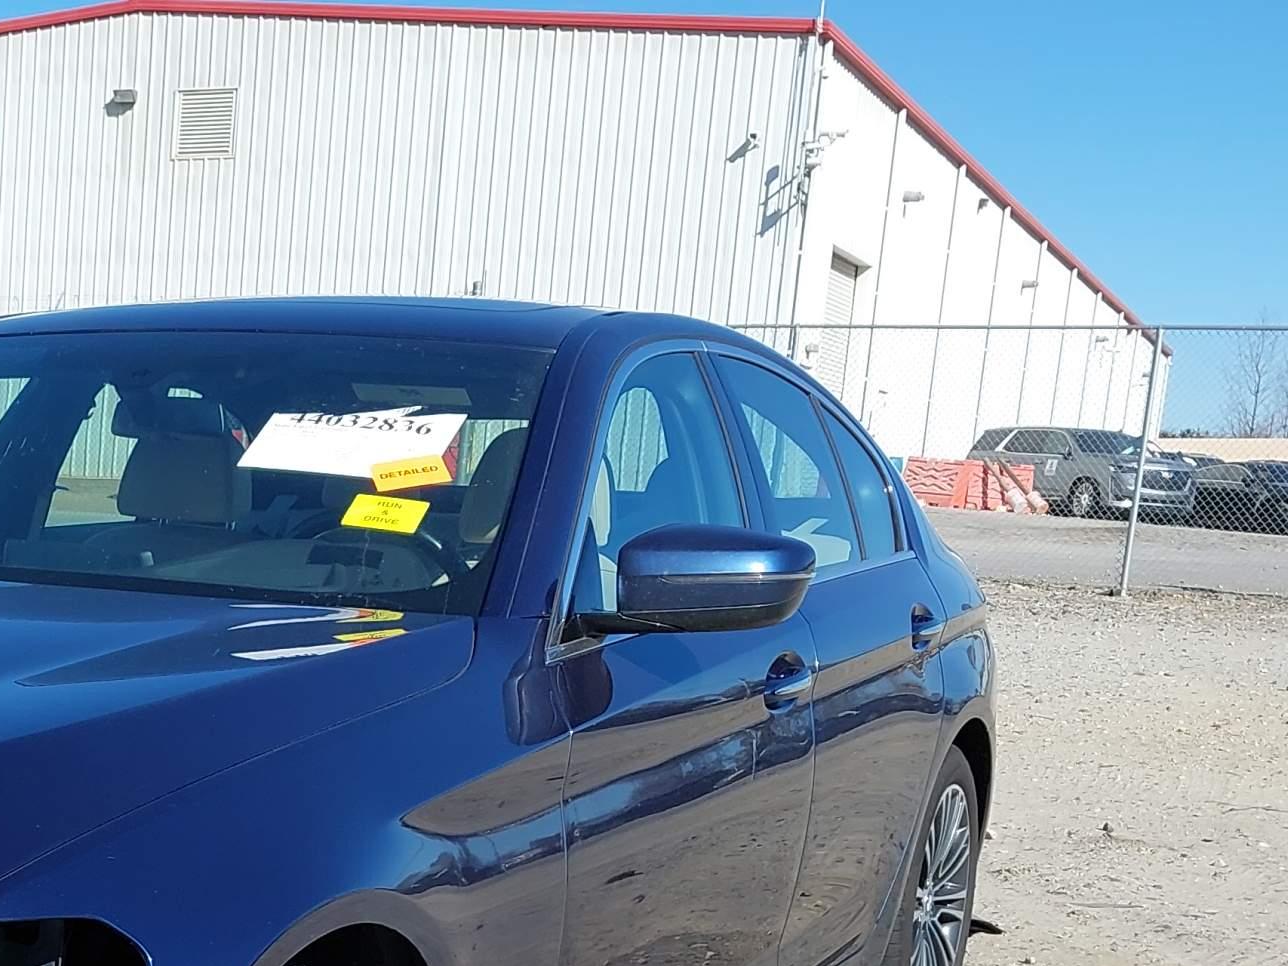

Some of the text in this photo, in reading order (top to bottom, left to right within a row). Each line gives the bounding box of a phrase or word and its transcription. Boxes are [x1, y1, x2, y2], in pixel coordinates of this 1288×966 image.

[289, 412, 434, 435] 44032836
[379, 465, 439, 480] DETAILED
[377, 501, 402, 510] RUN
[363, 515, 400, 525] DRIVE
